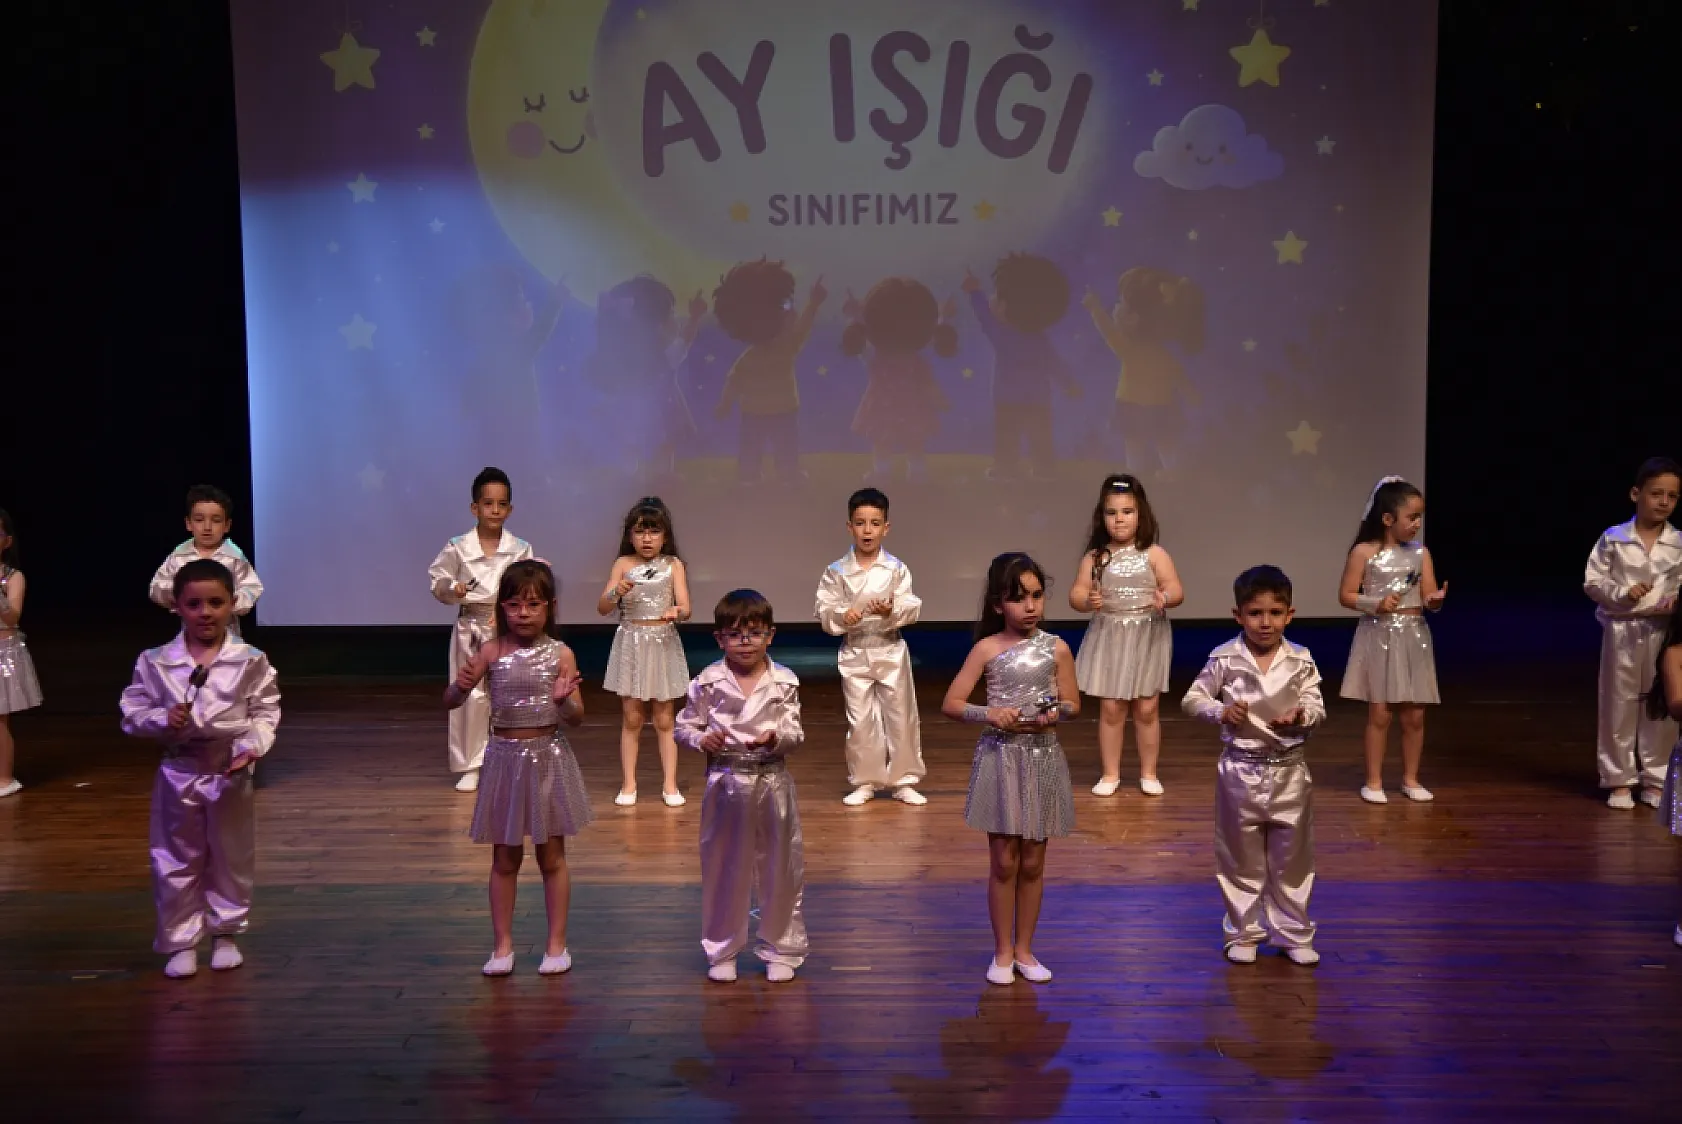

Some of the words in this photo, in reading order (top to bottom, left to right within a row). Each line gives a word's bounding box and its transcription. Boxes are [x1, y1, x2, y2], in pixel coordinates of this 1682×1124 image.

[642, 40, 775, 177] AY
[829, 24, 1093, 174] IŞIĞI
[768, 193, 959, 226] SINIFIMIZ
